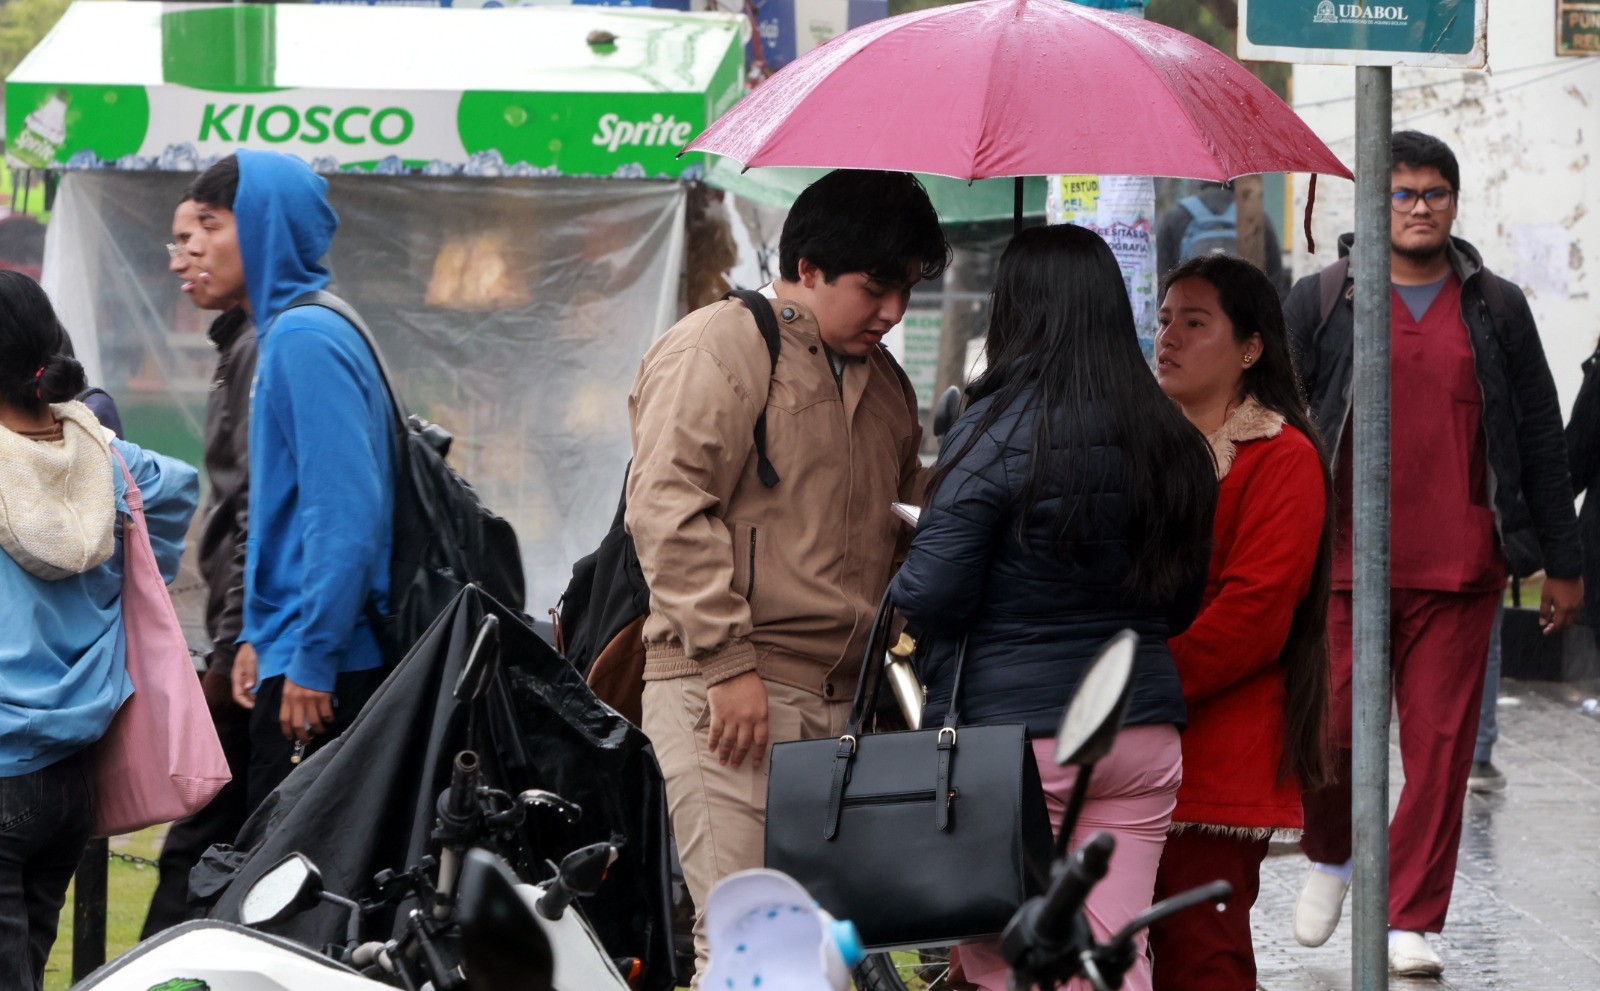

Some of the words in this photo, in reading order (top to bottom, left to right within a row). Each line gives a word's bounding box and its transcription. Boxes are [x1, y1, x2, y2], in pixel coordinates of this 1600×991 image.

[1338, 4, 1409, 20] UDABOL
[198, 103, 414, 146] KIOSCO
[591, 112, 693, 153] Sprite
